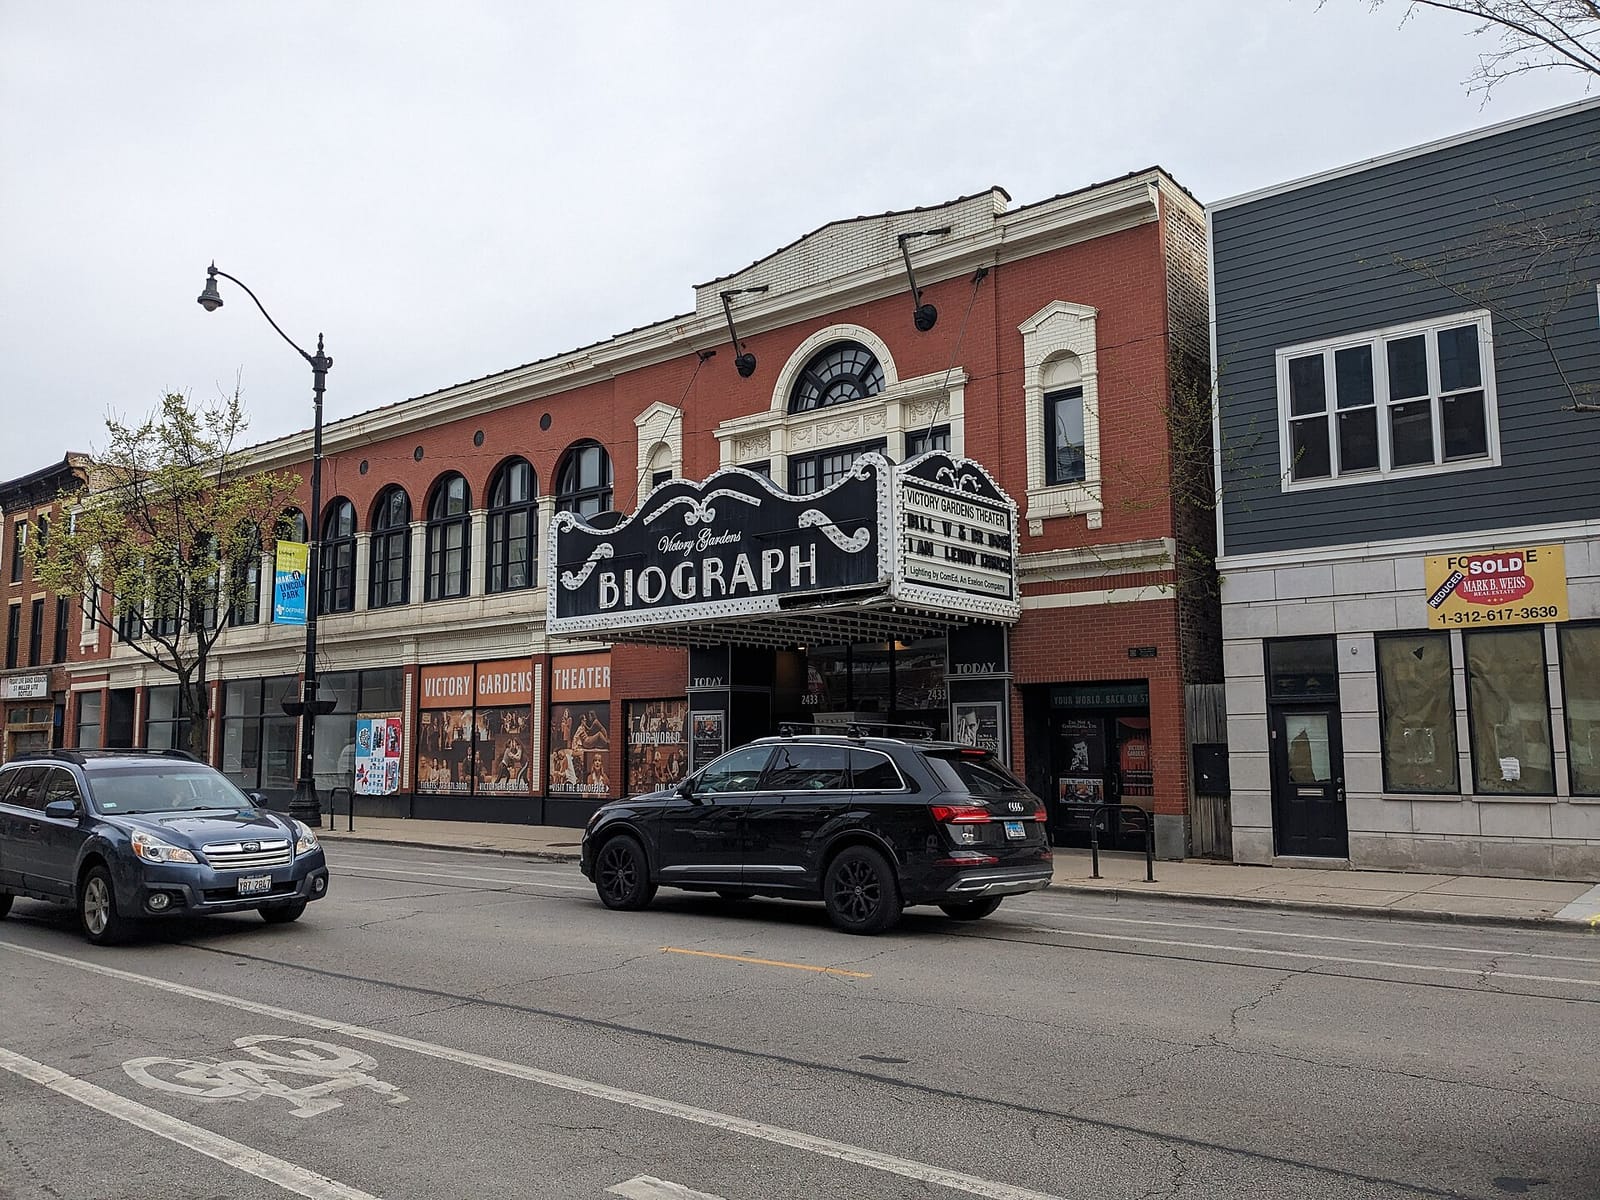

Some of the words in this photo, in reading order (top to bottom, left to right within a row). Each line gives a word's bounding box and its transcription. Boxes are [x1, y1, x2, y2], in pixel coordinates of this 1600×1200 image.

[907, 489, 939, 510] VICTORY
[941, 499, 974, 519] GARDENS
[976, 508, 1005, 527] THEATER
[907, 512, 935, 533] BILL
[942, 521, 952, 538] W
[658, 532, 695, 557] Victory
[696, 528, 742, 552] Gardens
[908, 538, 914, 553] I
[916, 540, 934, 558] AM
[1470, 558, 1523, 575] SOLD
[276, 575, 293, 584] MAKE
[599, 543, 816, 609] BIOGRAPH
[910, 566, 932, 579] Lighting
[932, 570, 939, 580] by
[960, 576, 968, 584] An
[984, 580, 1006, 593] Company
[1463, 580, 1489, 593] MARK
[1490, 579, 1498, 591] B.
[1499, 576, 1526, 589] WEISS
[282, 590, 300, 600] PARK
[1429, 572, 1463, 608] REDUCED
[1439, 606, 1558, 624] 1-312-617-3630
[955, 662, 996, 674] TODAY
[424, 676, 470, 697] VICTORY
[479, 672, 532, 694] GARDENS
[554, 666, 610, 690] THEATER
[694, 676, 722, 687] TODAY
[802, 695, 818, 704] 2433
[928, 690, 946, 700] 2433
[1054, 696, 1072, 705] YOUR
[631, 732, 651, 744] YOUR
[551, 784, 564, 792] VISIT
[566, 784, 576, 792] THE
[576, 784, 586, 792] BOX
[587, 783, 605, 792] OFFICE
